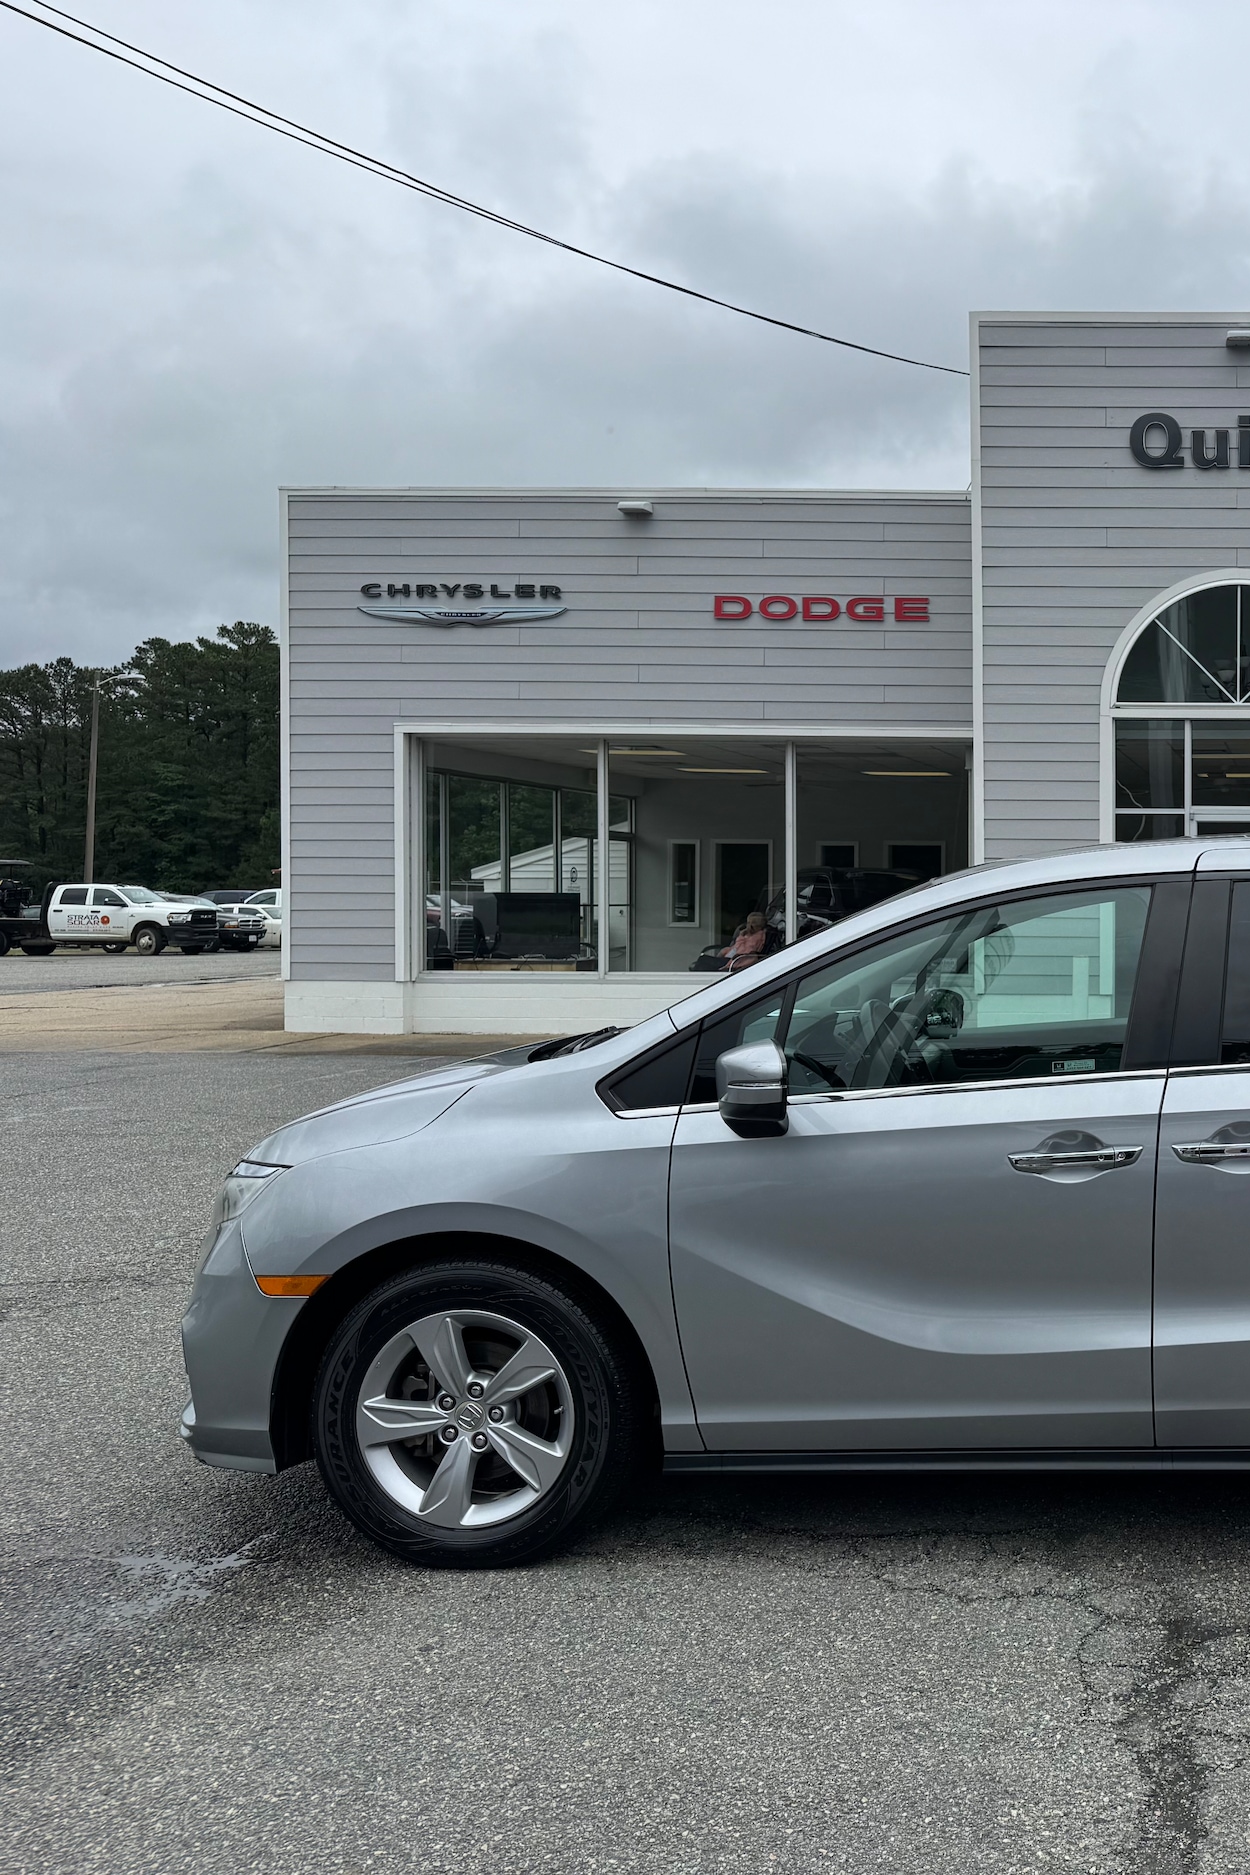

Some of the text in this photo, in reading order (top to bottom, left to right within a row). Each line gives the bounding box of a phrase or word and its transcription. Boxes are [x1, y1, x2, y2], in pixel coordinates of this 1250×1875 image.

[360, 583, 562, 600] CHRYSLER
[714, 595, 930, 622] DODGE
[534, 1309, 600, 1488] GOODYEAR
